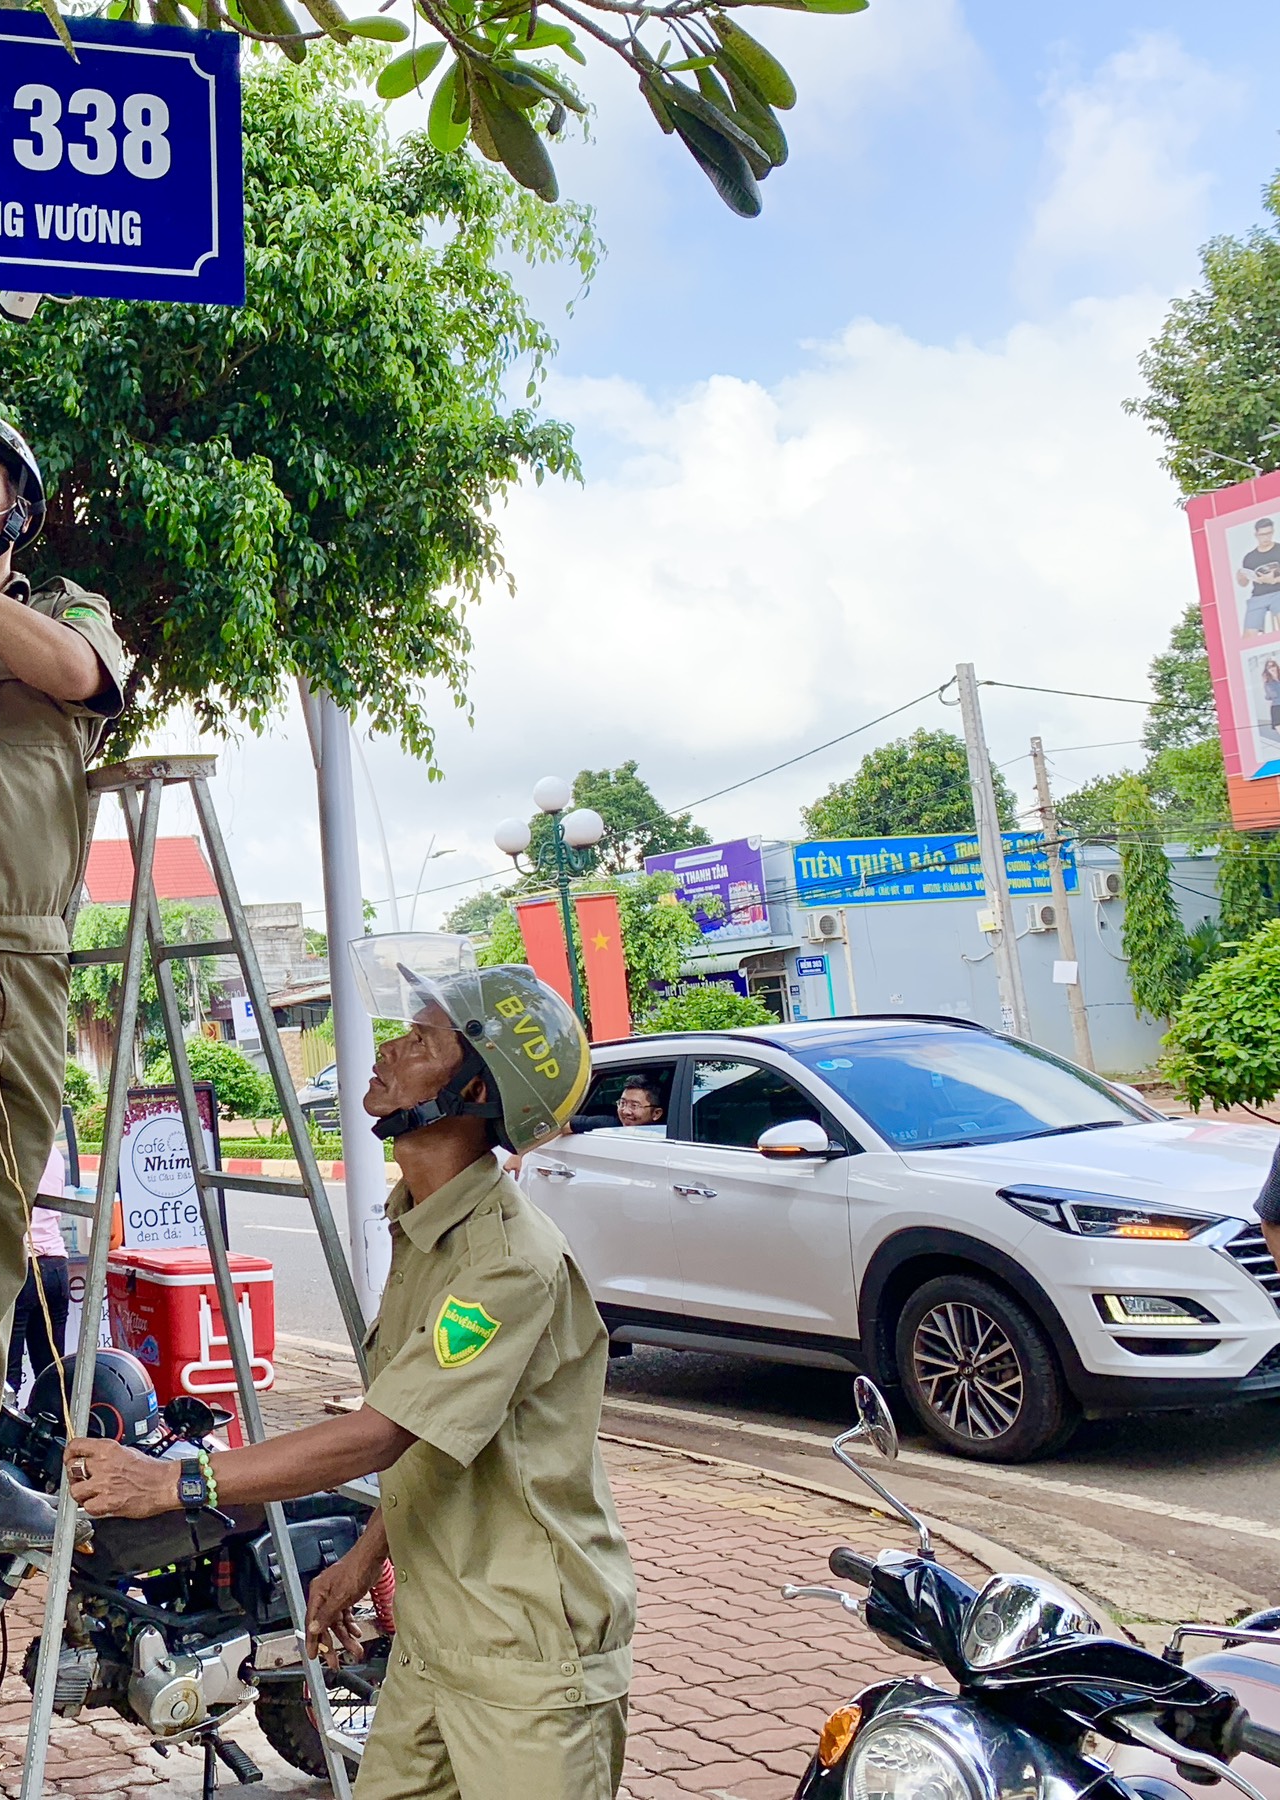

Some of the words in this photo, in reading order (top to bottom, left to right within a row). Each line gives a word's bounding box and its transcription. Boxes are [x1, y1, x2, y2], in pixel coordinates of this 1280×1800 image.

[12, 83, 171, 180] 338
[34, 201, 143, 246] VƯƠNG
[494, 995, 561, 1080] BVDP
[136, 1137, 166, 1155] café
[143, 1153, 193, 1173] Nhím
[129, 1200, 199, 1229] coffe
